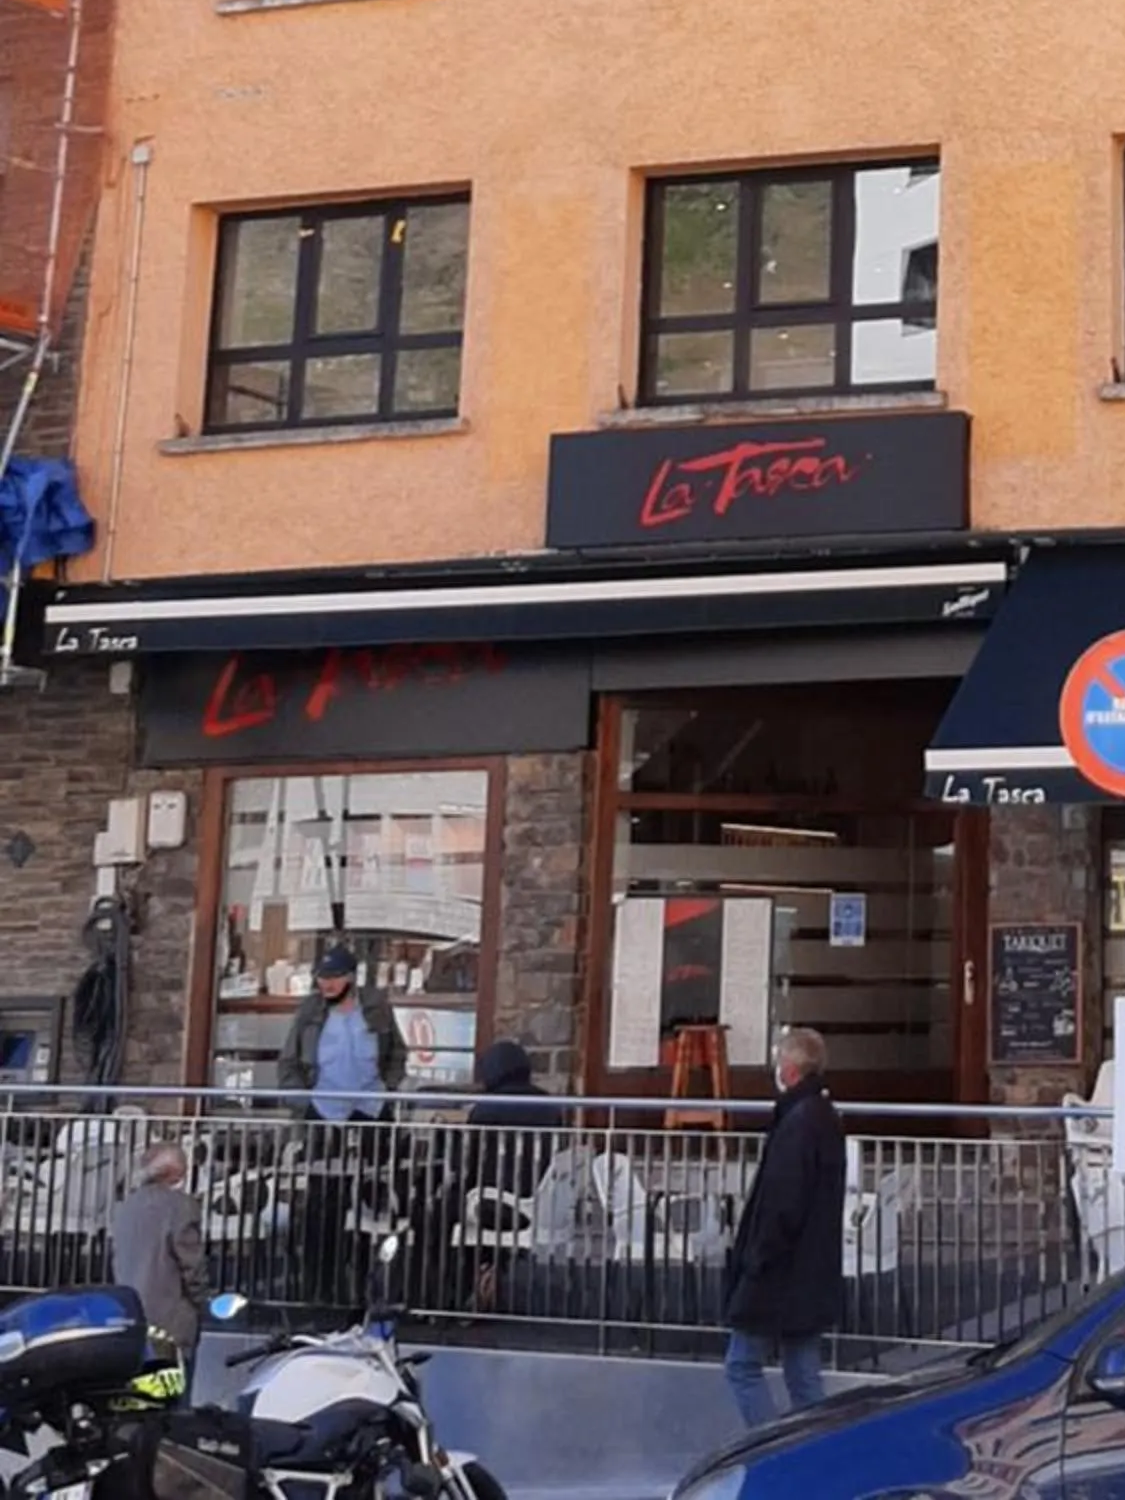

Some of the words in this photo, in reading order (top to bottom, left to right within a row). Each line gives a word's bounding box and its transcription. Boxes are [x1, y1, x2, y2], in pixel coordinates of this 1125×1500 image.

[639, 458, 696, 528] La
[55, 627, 79, 652] La
[87, 626, 138, 652] Tasca
[942, 774, 971, 803] La
[982, 776, 1046, 804] Tasca
